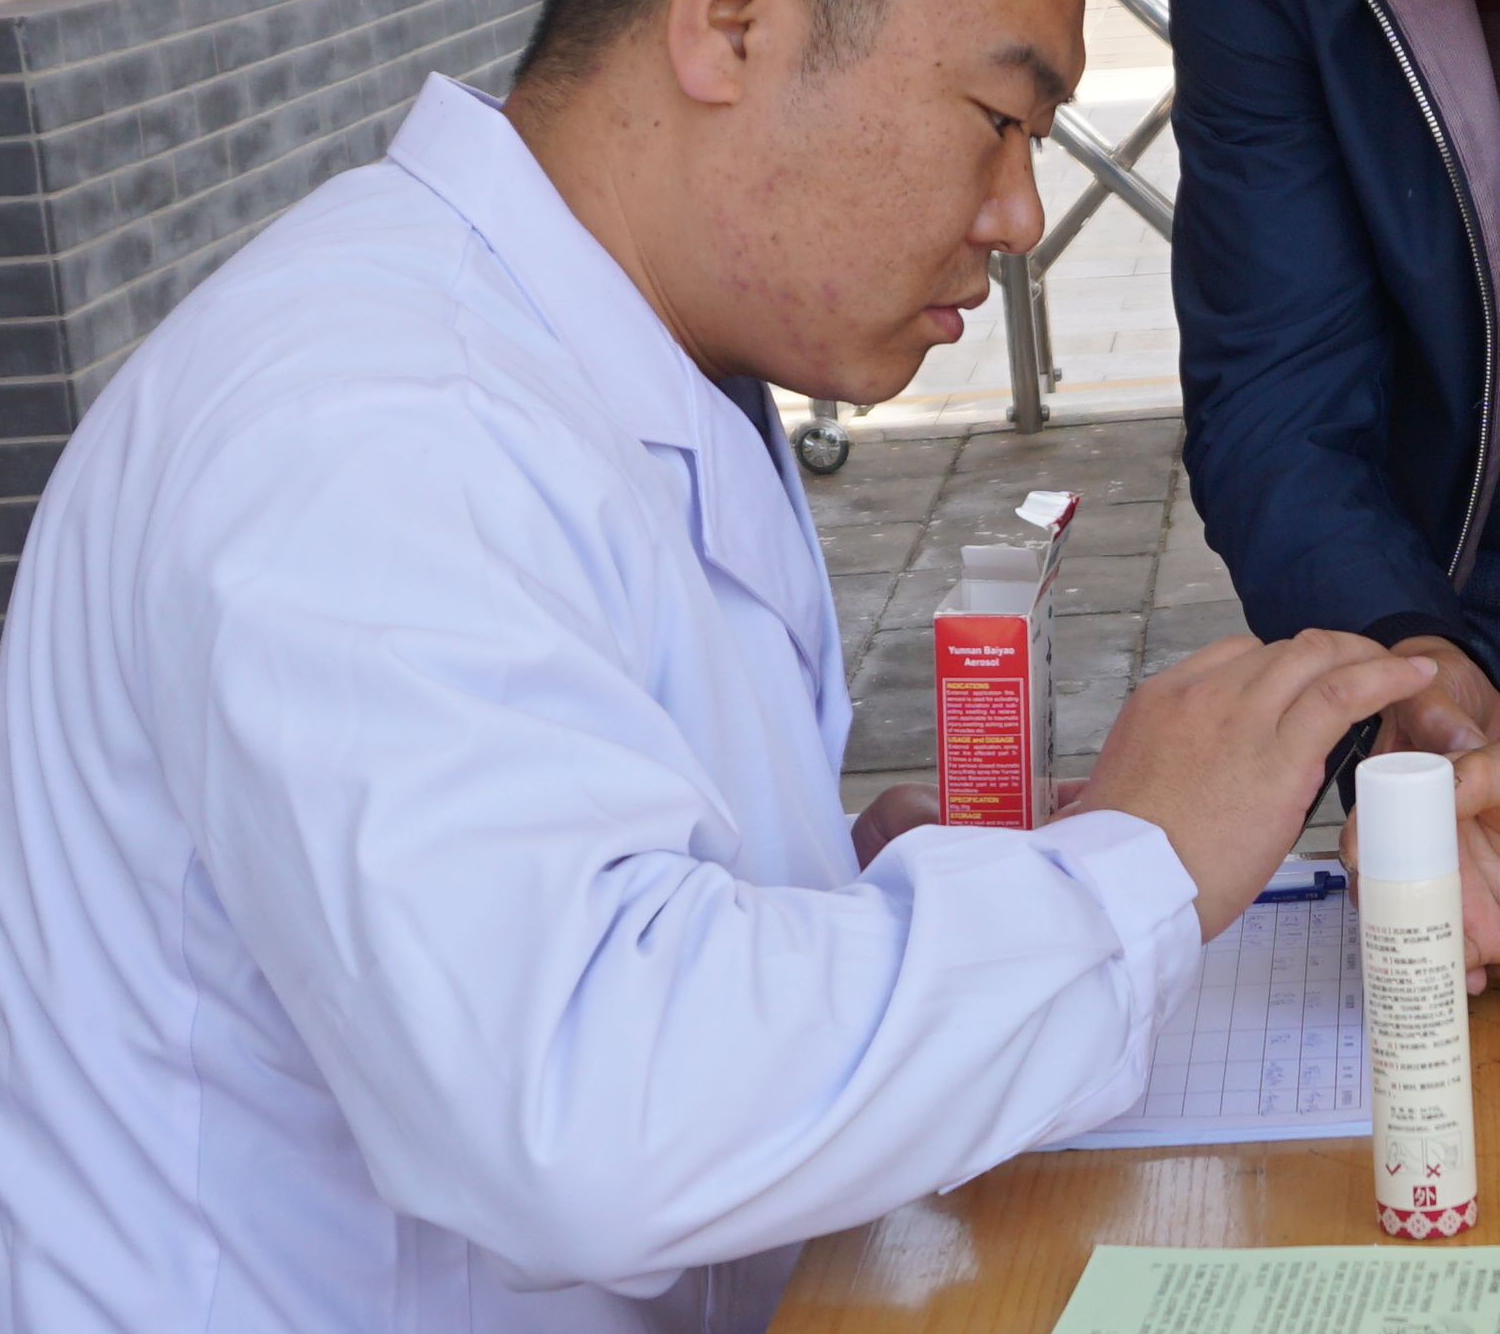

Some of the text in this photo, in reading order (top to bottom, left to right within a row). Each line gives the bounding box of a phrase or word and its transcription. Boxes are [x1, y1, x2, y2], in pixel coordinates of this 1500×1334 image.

[947, 645, 1015, 656] Yunnan Baiyao
[964, 657, 1000, 667] Aerosol
[1414, 1186, 1437, 1207] 外
